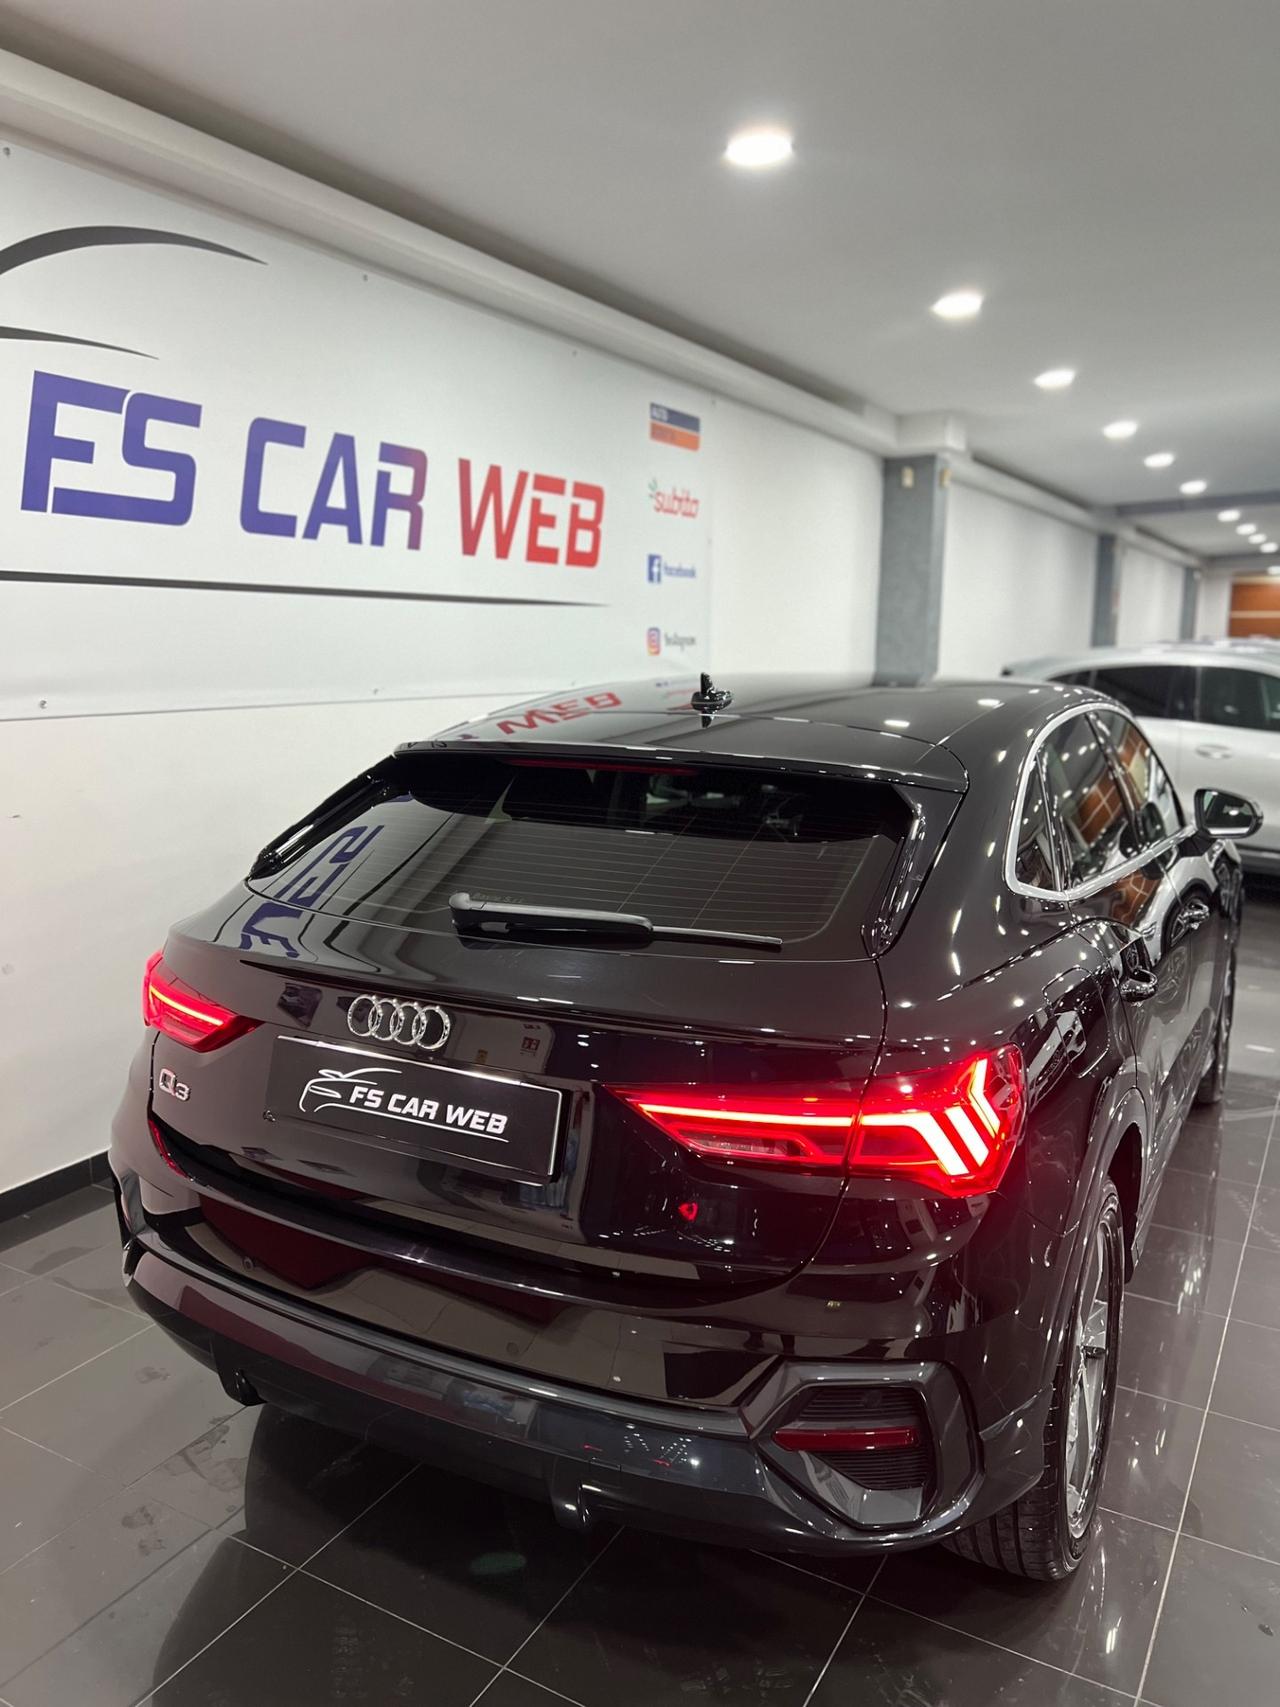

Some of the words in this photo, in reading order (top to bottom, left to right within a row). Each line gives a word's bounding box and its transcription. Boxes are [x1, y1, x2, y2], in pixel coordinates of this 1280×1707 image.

[21, 370, 202, 527] FS
[240, 417, 428, 550] CAR
[458, 458, 605, 569] WEB
[655, 488, 700, 518] subito
[159, 1068, 190, 1101] Q3
[350, 1086, 384, 1108] FS
[387, 1094, 439, 1120] CAR
[446, 1104, 508, 1134] WEB
